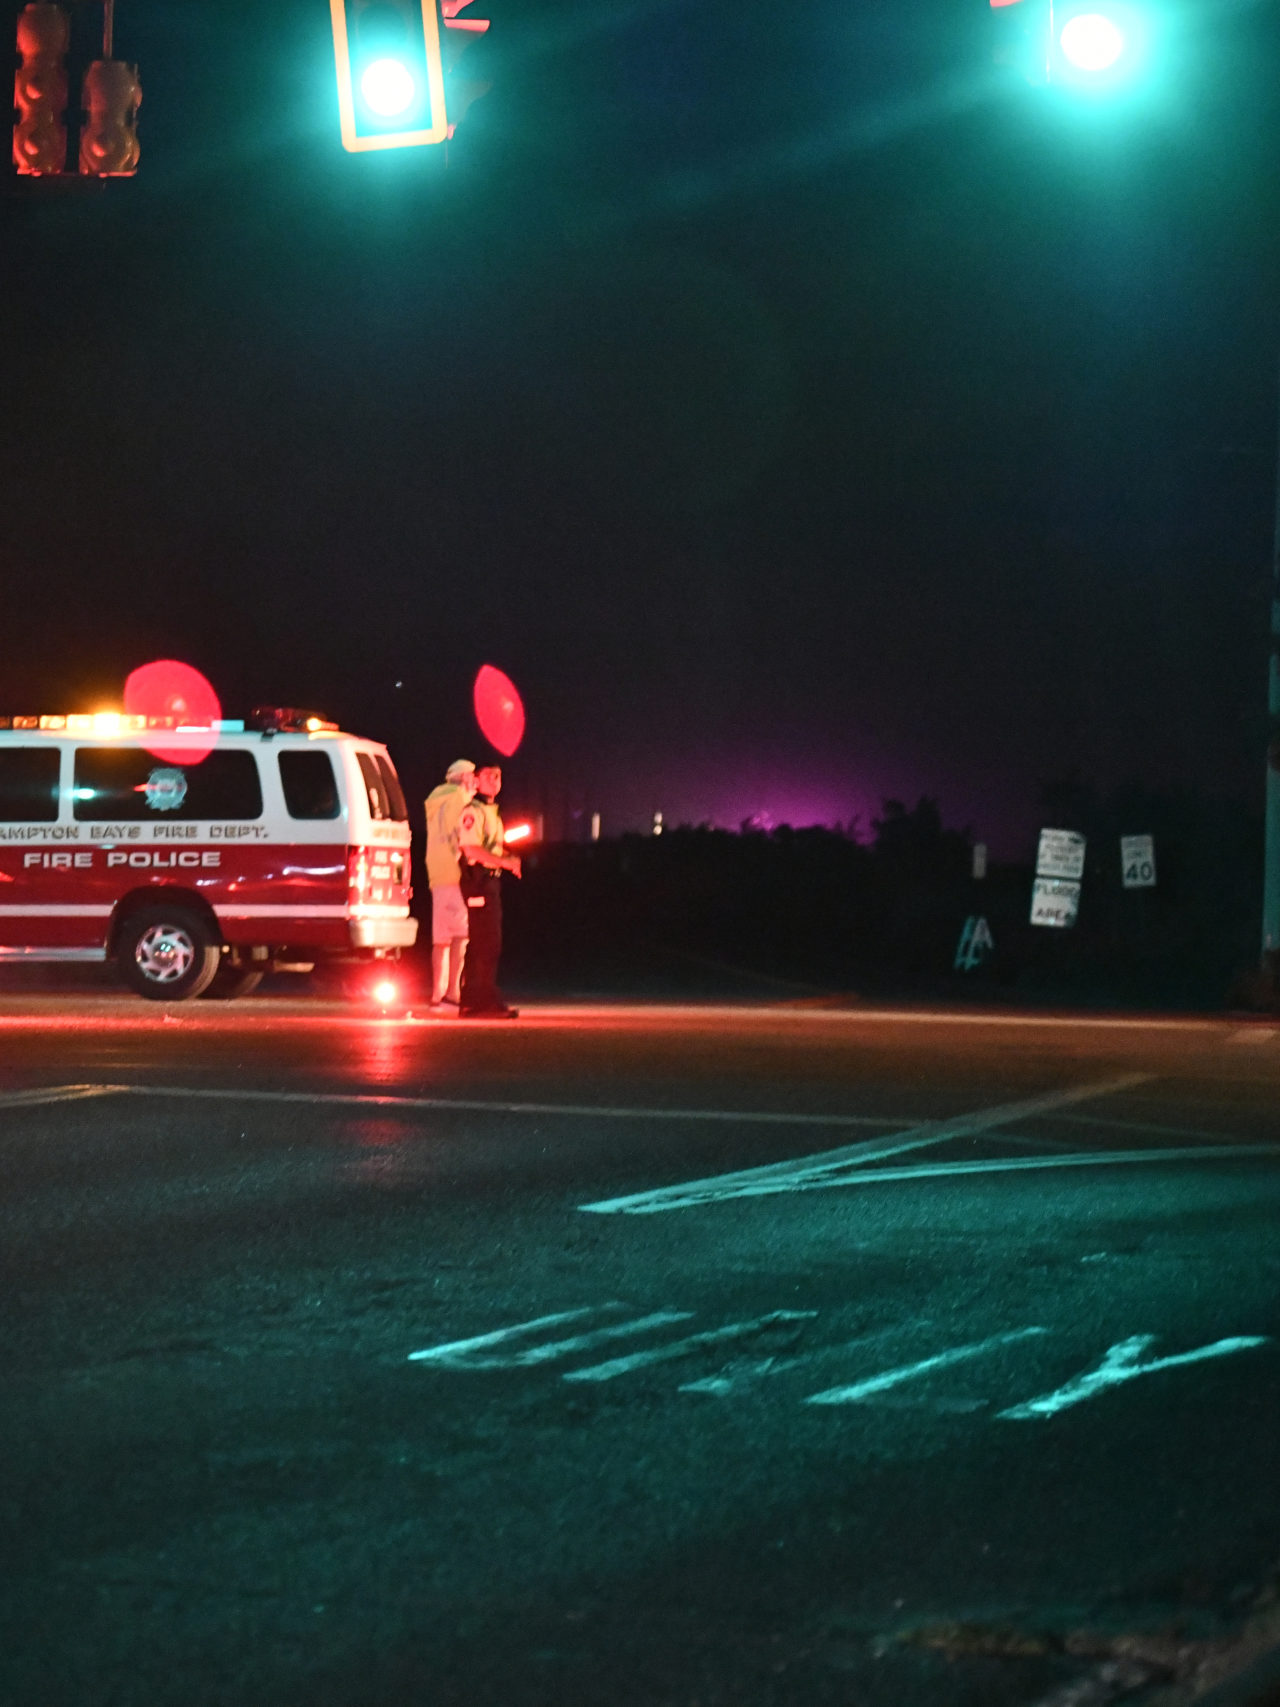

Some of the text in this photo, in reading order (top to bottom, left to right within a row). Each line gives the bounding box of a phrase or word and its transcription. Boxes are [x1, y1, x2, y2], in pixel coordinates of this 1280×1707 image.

[90, 825, 141, 839] BAYS
[154, 825, 198, 838] FIRE
[209, 824, 270, 838] DEPT.
[23, 851, 222, 868] FIRE POLICE
[1126, 861, 1153, 881] 40
